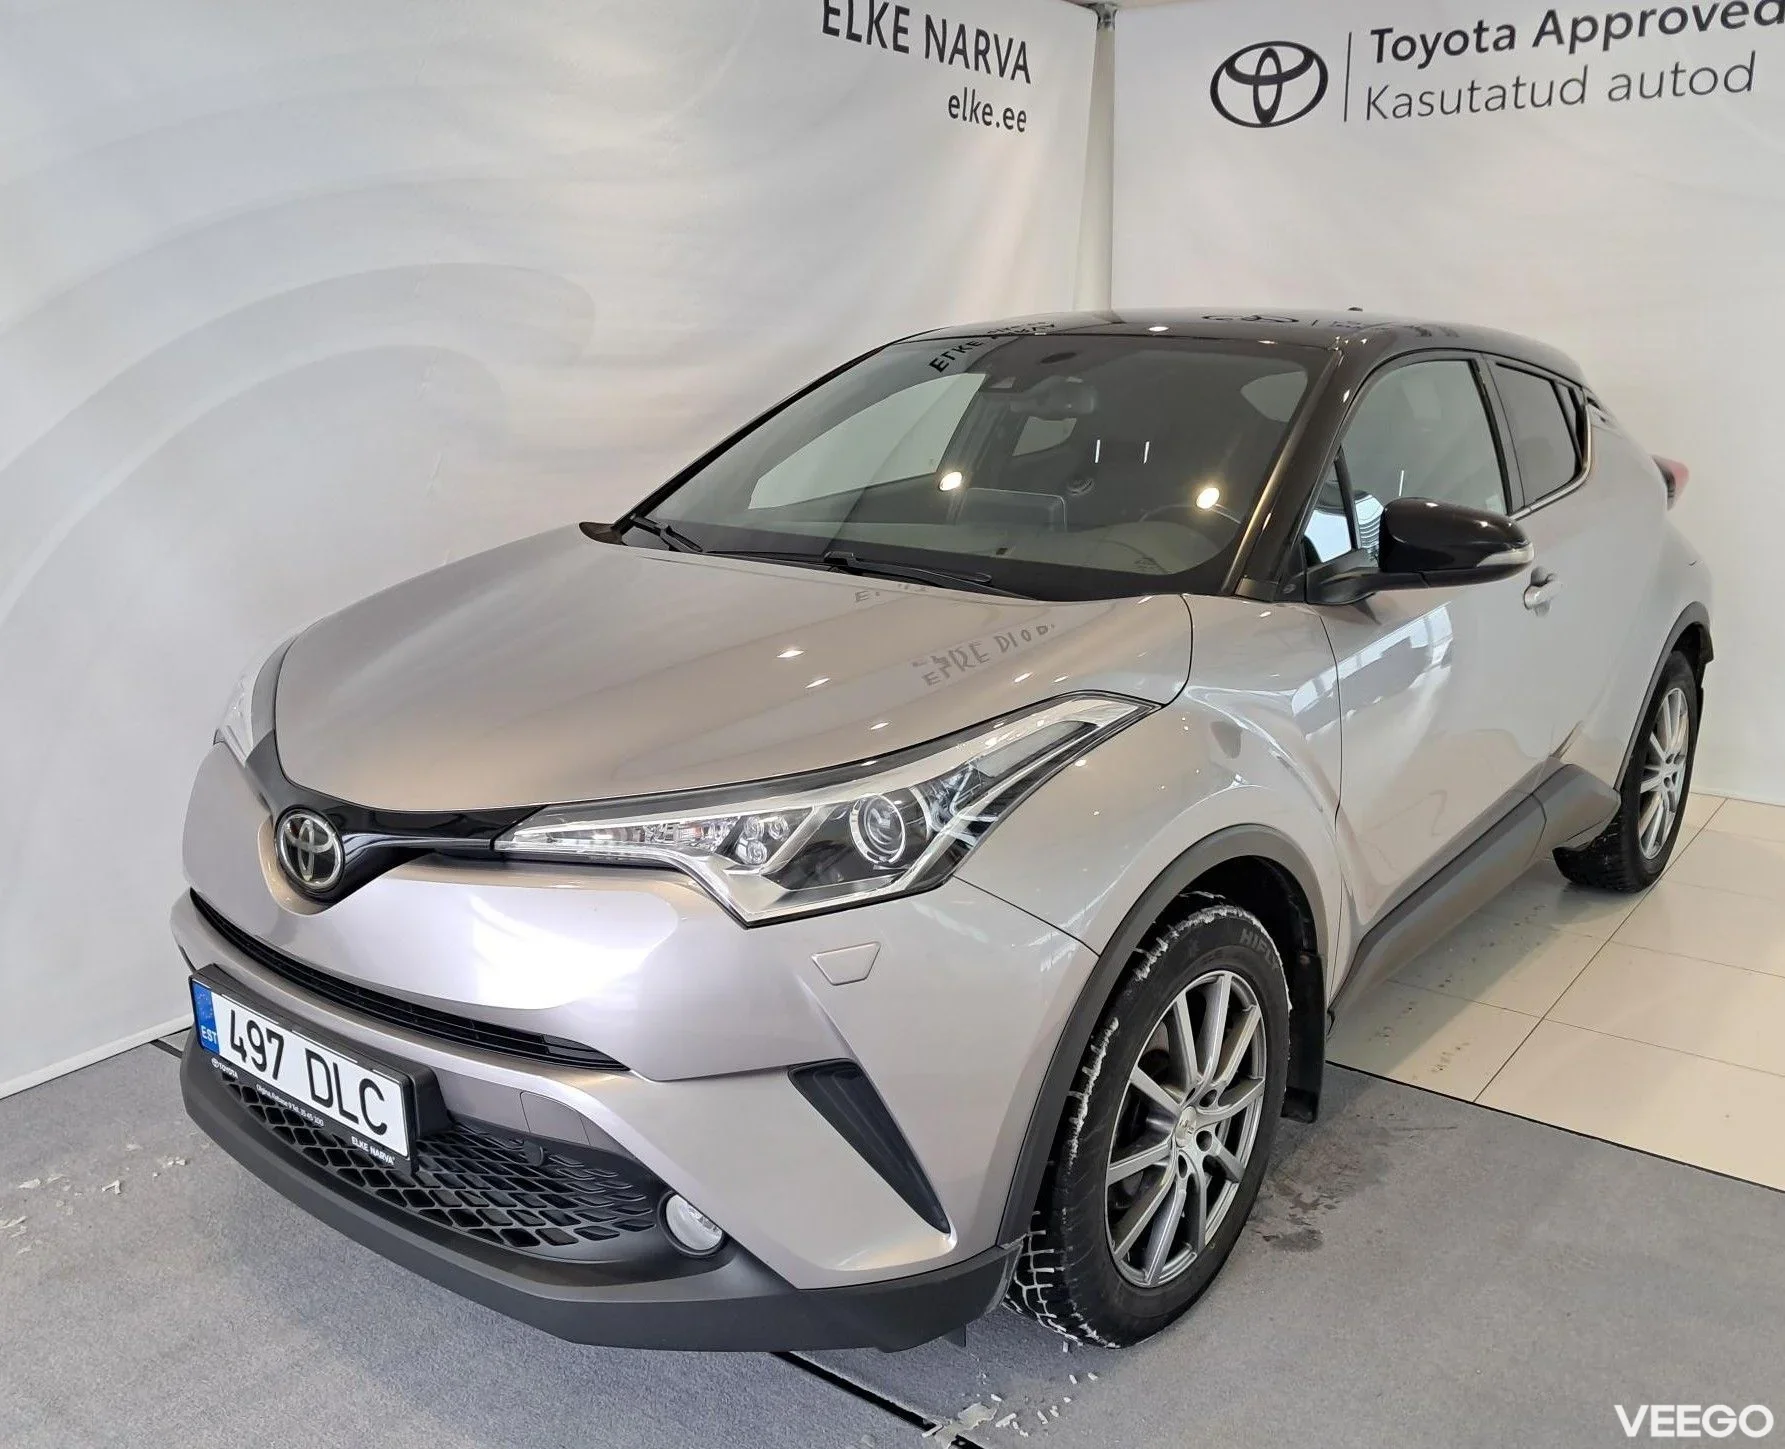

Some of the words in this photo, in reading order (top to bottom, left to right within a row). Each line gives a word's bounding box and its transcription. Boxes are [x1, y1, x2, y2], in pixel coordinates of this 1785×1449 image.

[822, 0, 910, 54] ELKE
[924, 14, 1031, 84] NARVA
[1370, 19, 1517, 70] Toyota
[1531, 0, 1785, 54] Approved
[948, 86, 1027, 133] elke.ee
[1366, 64, 1589, 121] Kasutatud
[1607, 50, 1757, 102] autod
[200, 1025, 218, 1044] EST
[229, 1008, 285, 1081] 497
[304, 1047, 388, 1136] DLC
